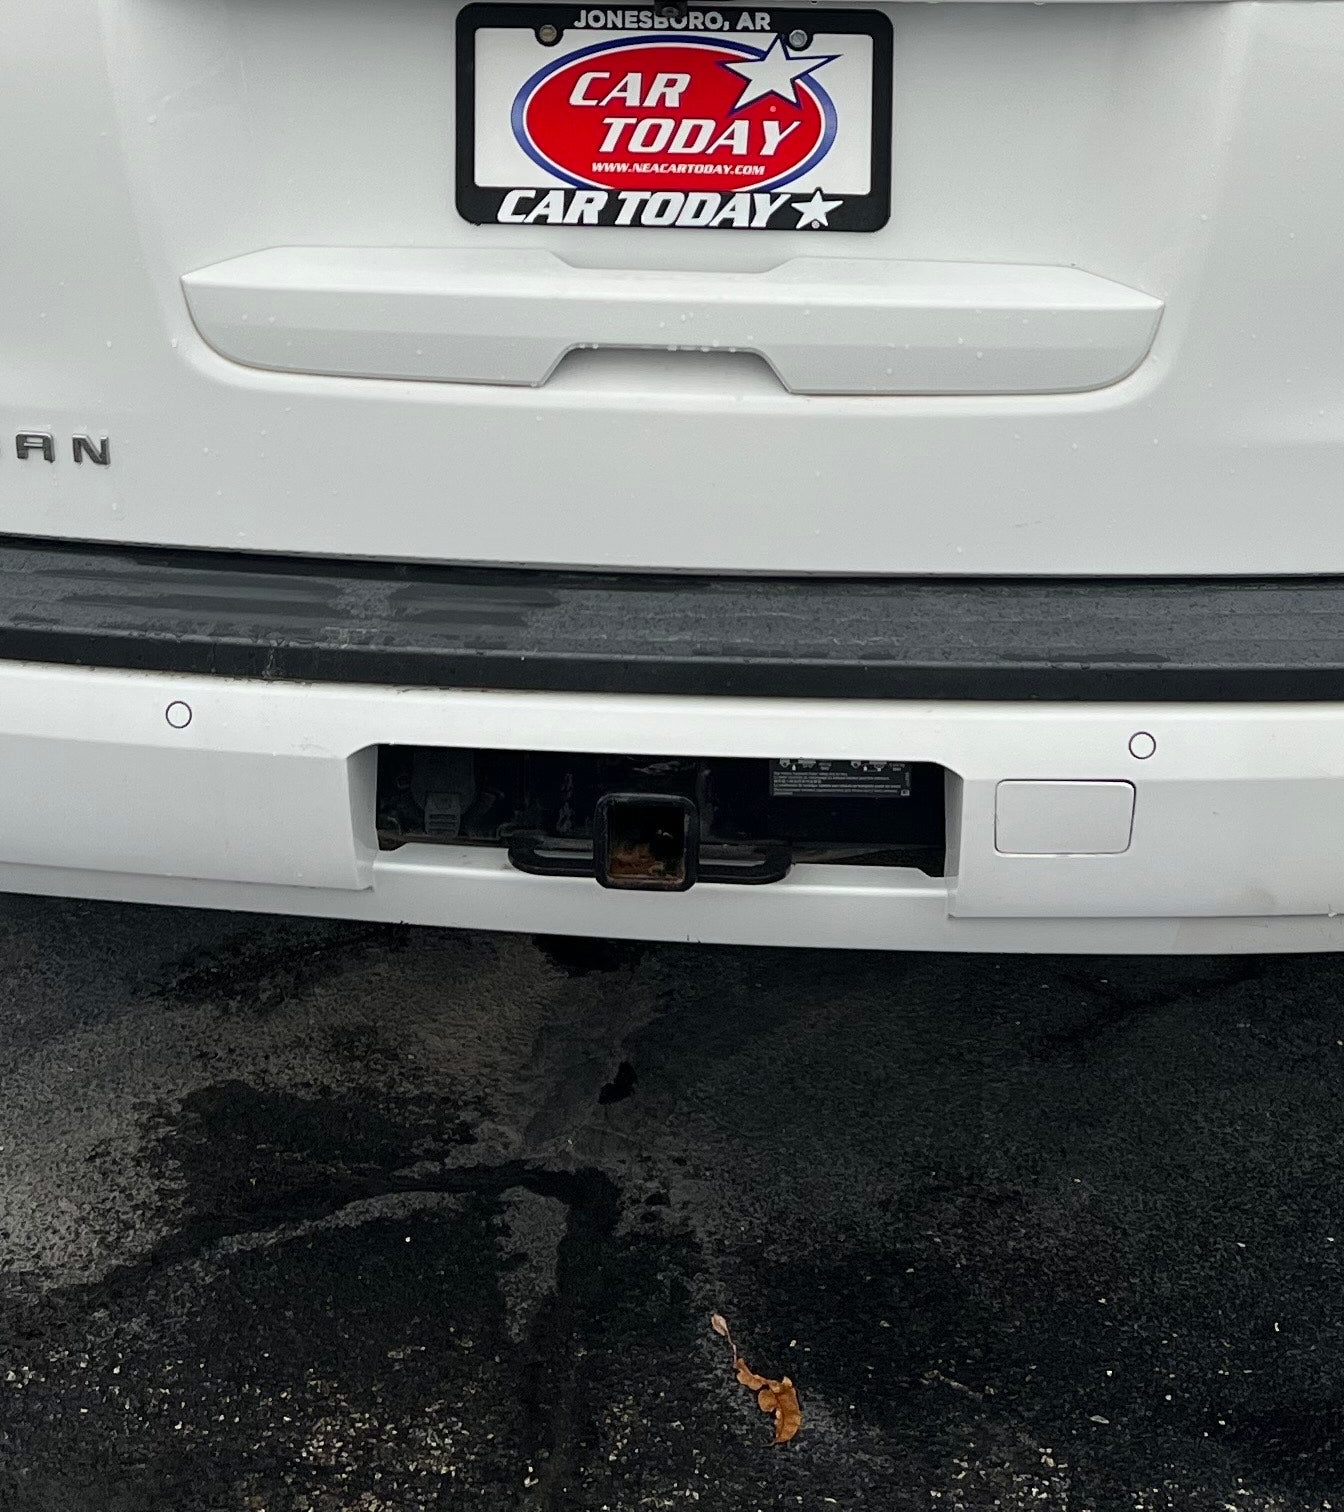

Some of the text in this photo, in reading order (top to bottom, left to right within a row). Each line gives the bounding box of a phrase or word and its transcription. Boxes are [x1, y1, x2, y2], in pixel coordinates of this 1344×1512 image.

[735, 11, 771, 31] AR
[568, 71, 691, 108] CAR
[598, 117, 801, 156] TODAY
[591, 161, 765, 176] WWW.NEACARTODAY.COM
[496, 189, 792, 229] CAR TODAY
